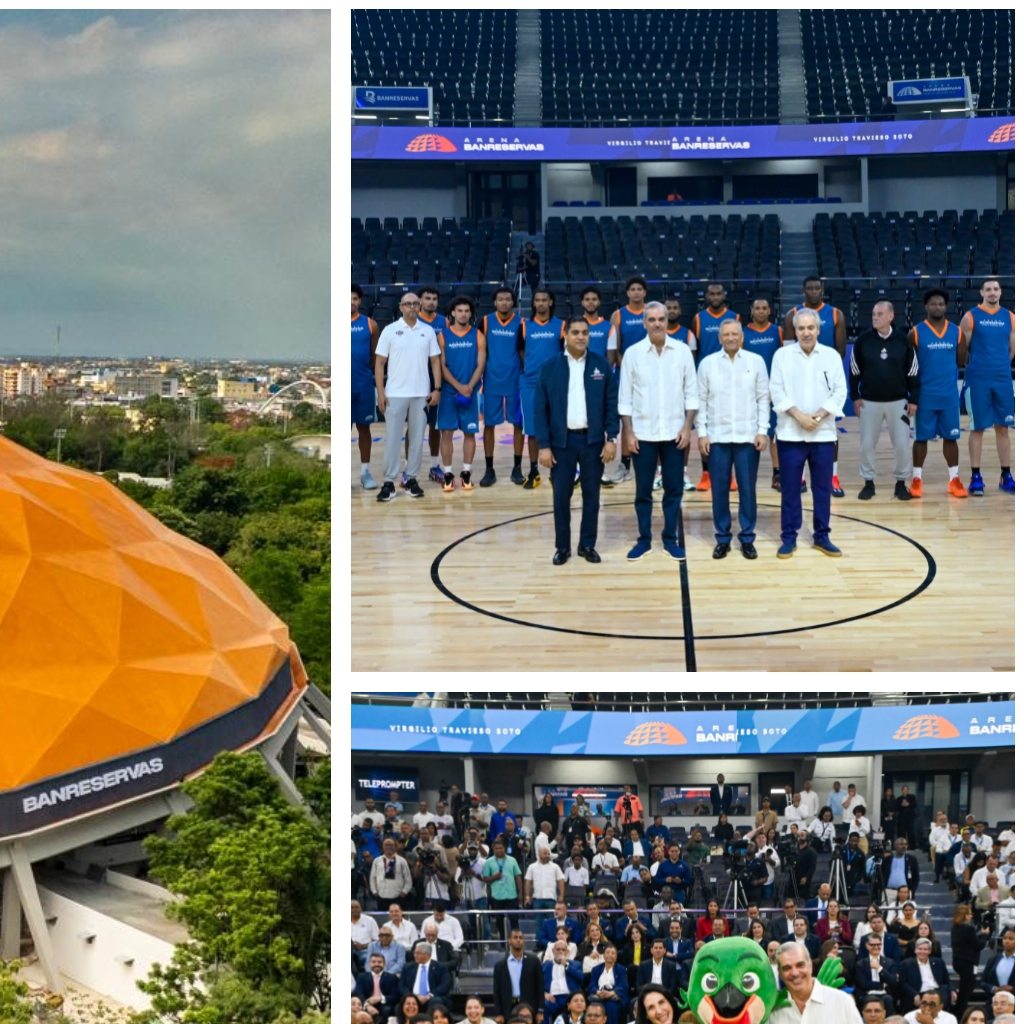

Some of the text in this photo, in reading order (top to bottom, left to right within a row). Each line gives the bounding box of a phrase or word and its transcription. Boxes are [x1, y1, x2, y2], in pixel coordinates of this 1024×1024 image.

[464, 143, 545, 151] BANRESERVAS
[671, 142, 750, 150] BANRESERVAS
[389, 725, 521, 736] VIRGILIO TRAVIESO SOTO
[762, 728, 787, 736] SOTO
[22, 757, 164, 813] BANRESERVAS
[358, 779, 416, 790] TELEPROMPTER
